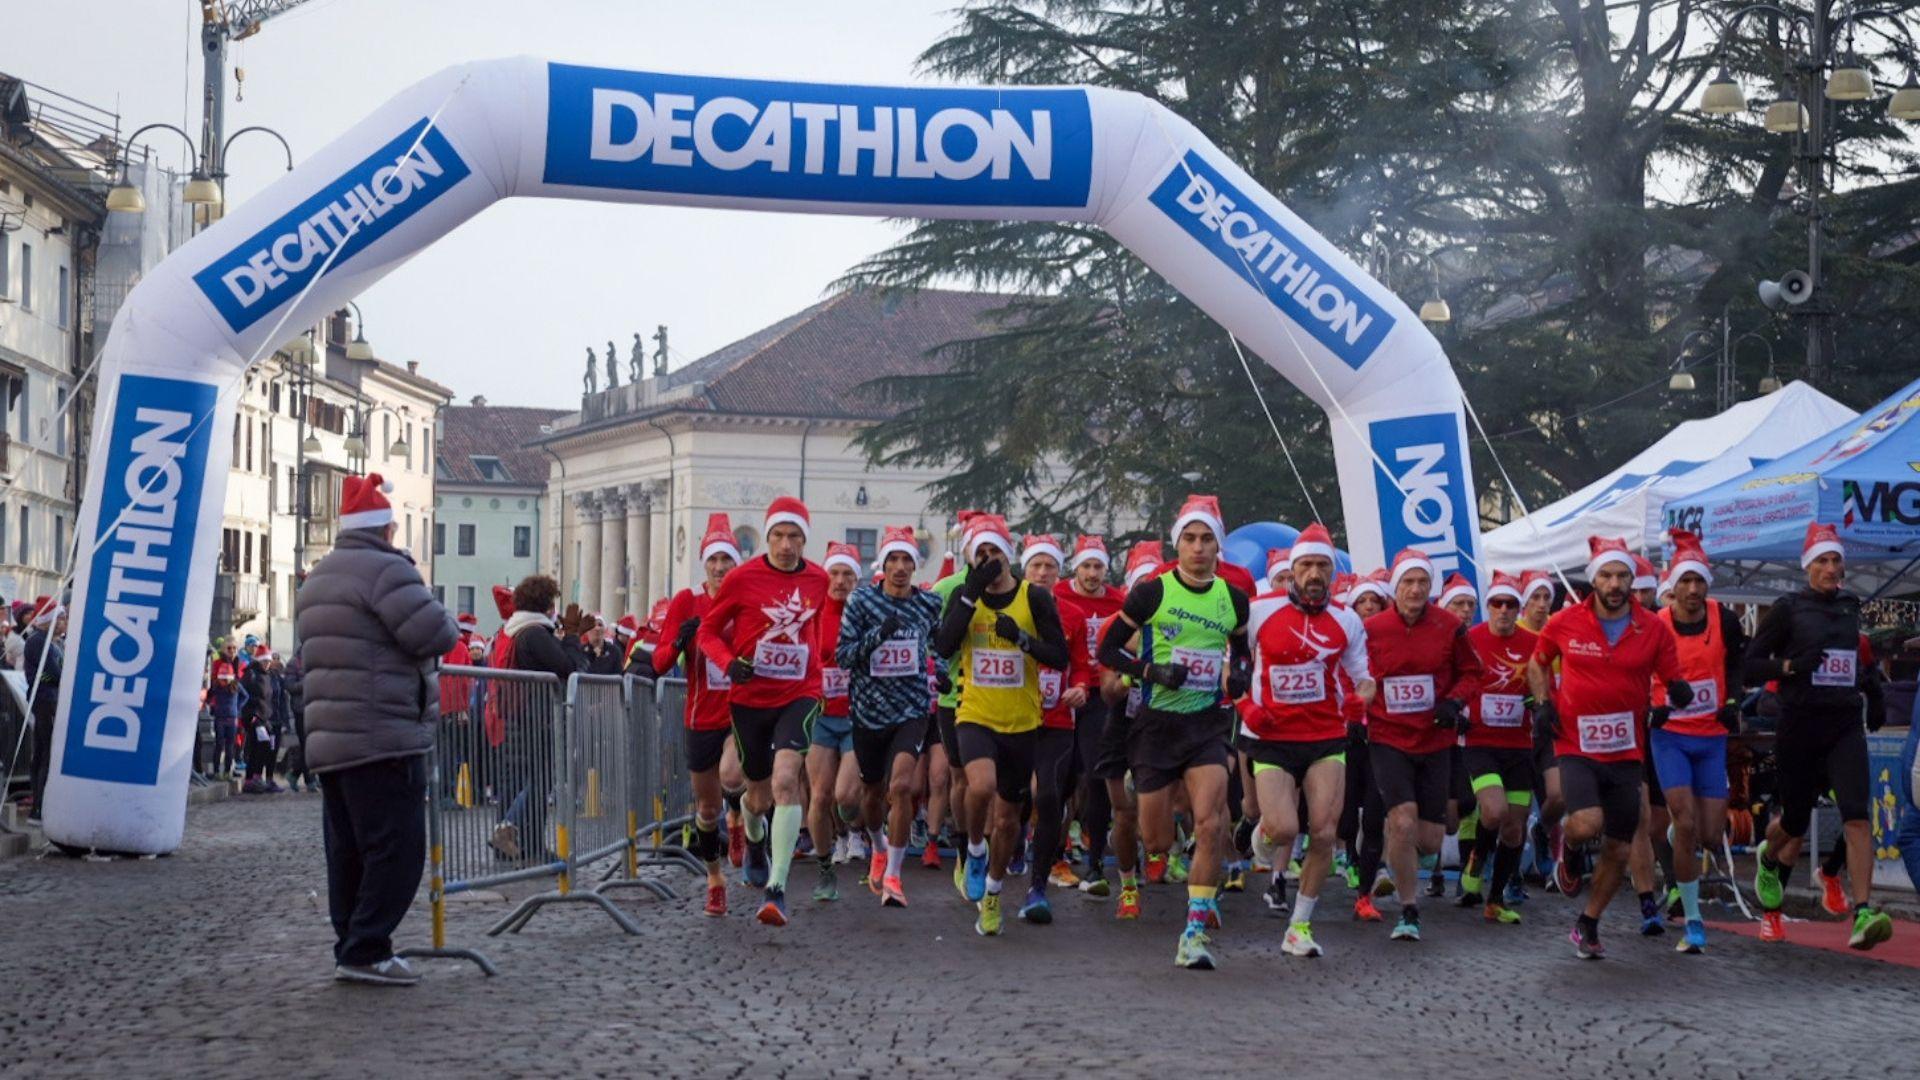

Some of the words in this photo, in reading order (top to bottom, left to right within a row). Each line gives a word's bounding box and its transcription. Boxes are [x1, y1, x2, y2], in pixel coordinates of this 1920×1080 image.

[590, 87, 1052, 181] DECATHLON
[221, 143, 444, 308] DECATHLON
[1176, 173, 1373, 346] DECATHLON
[83, 407, 192, 753] DECATHLON
[1167, 607, 1230, 635] alpenplu
[762, 650, 800, 668] 304
[879, 648, 911, 664] 219
[980, 658, 1015, 676] 218
[825, 673, 848, 688] 12
[1278, 673, 1317, 691] 225
[1391, 684, 1424, 701] 139
[1494, 702, 1515, 716] 37
[1586, 721, 1628, 741] 296
